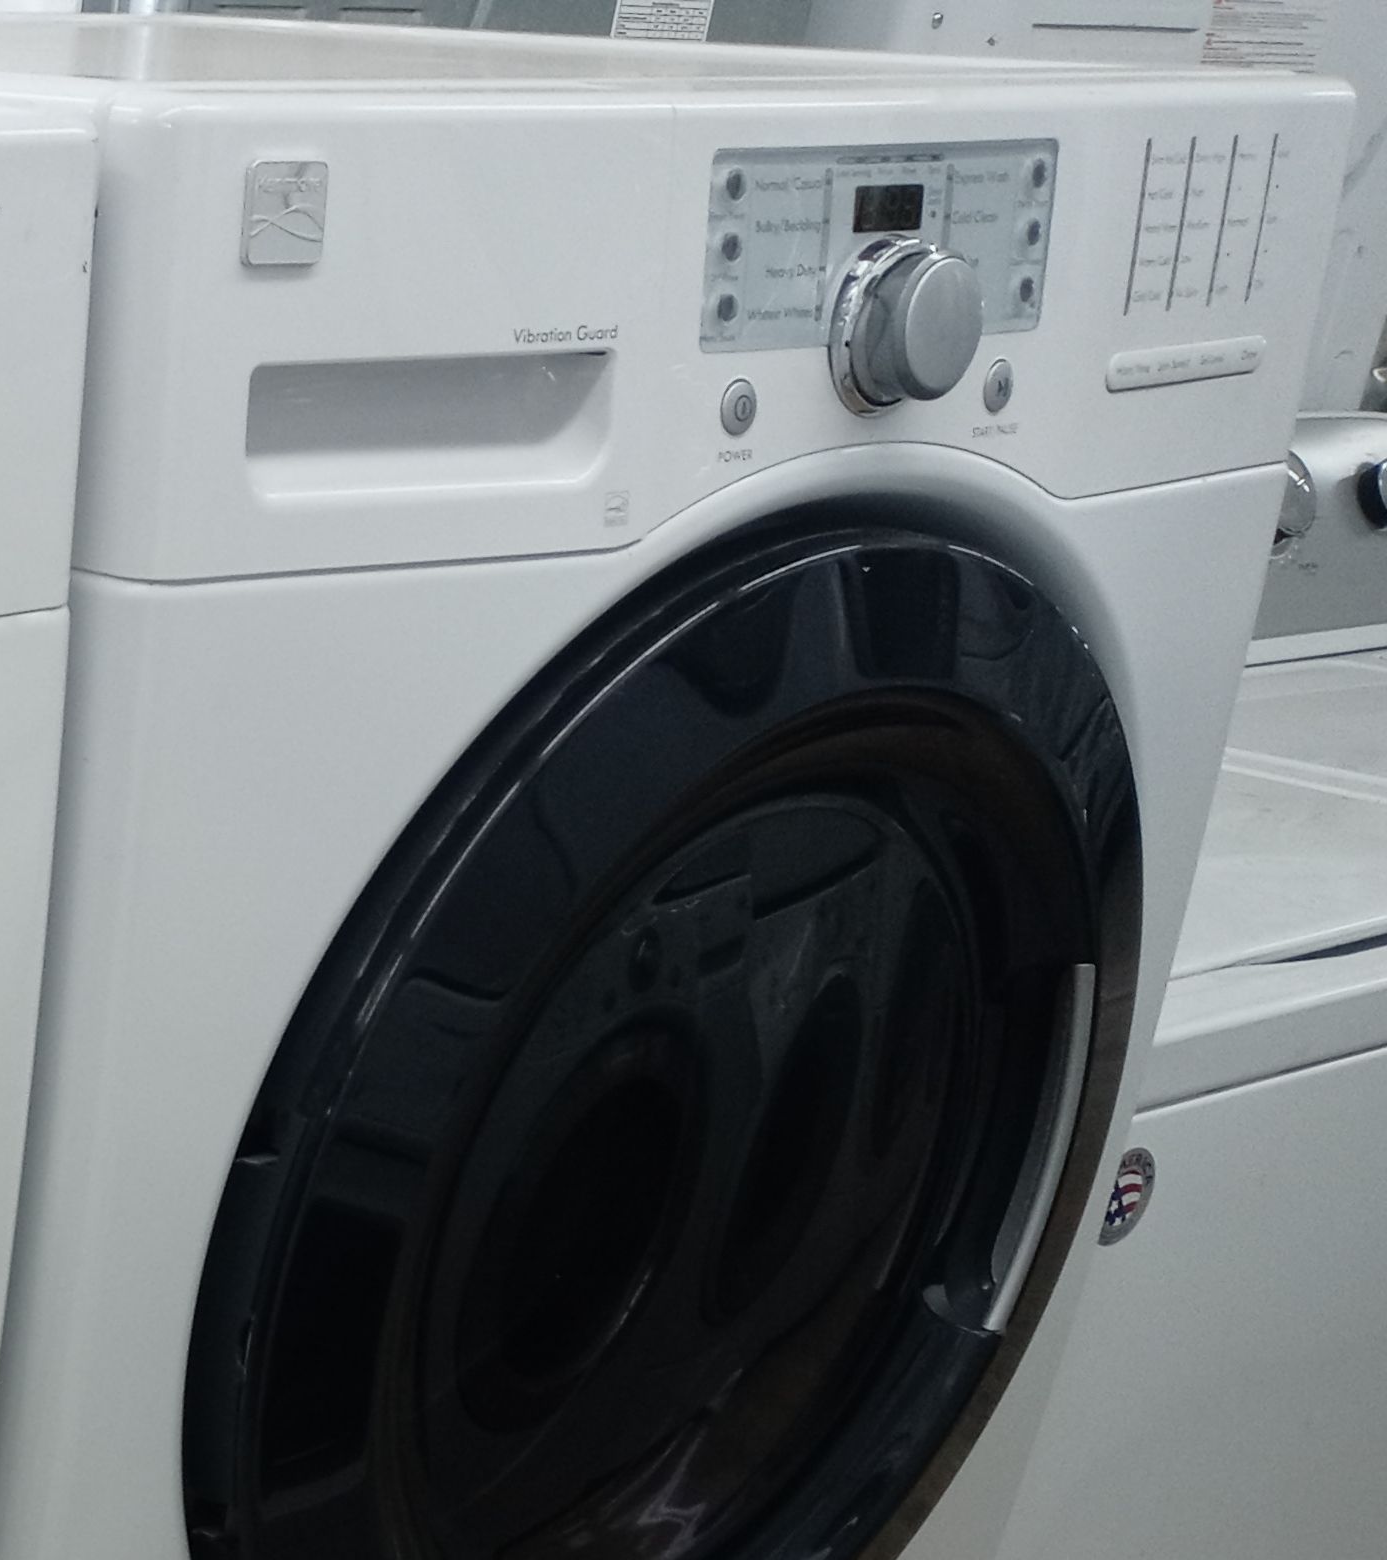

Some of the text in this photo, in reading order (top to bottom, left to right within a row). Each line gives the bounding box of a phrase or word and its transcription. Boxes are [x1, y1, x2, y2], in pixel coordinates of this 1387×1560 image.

[514, 325, 618, 344] Vibration Guard
[718, 450, 753, 462] POWER
